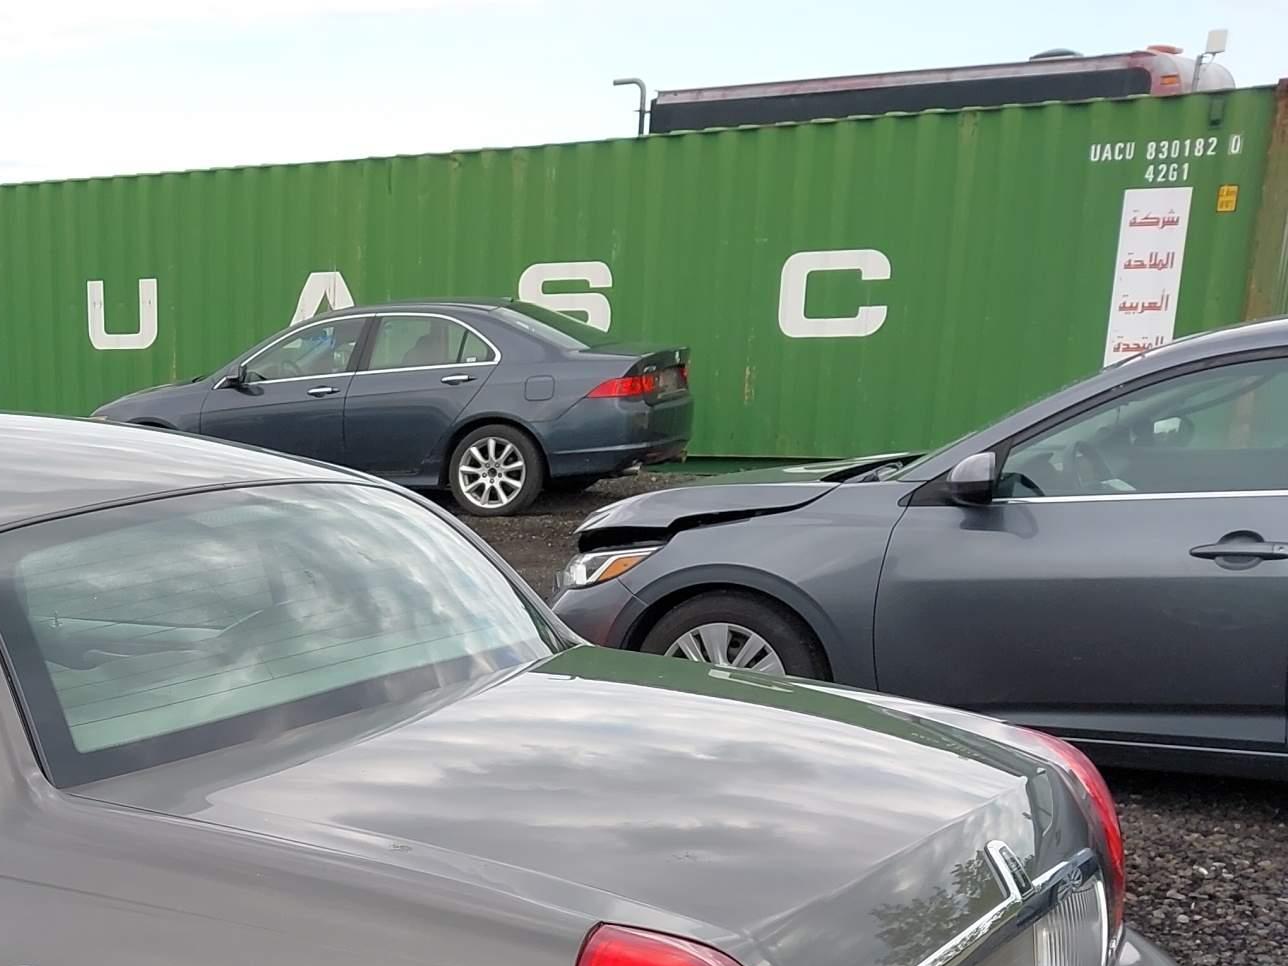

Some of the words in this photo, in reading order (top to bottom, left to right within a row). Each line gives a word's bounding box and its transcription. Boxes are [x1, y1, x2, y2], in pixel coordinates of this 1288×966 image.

[1090, 142, 1135, 162] UACU
[1146, 137, 1218, 160] 830182
[1230, 134, 1242, 155] 0
[1145, 162, 1190, 183] 42G1
[1128, 209, 1180, 229] شركة
[1123, 251, 1175, 270] الملاحة
[1118, 292, 1170, 315] العربية
